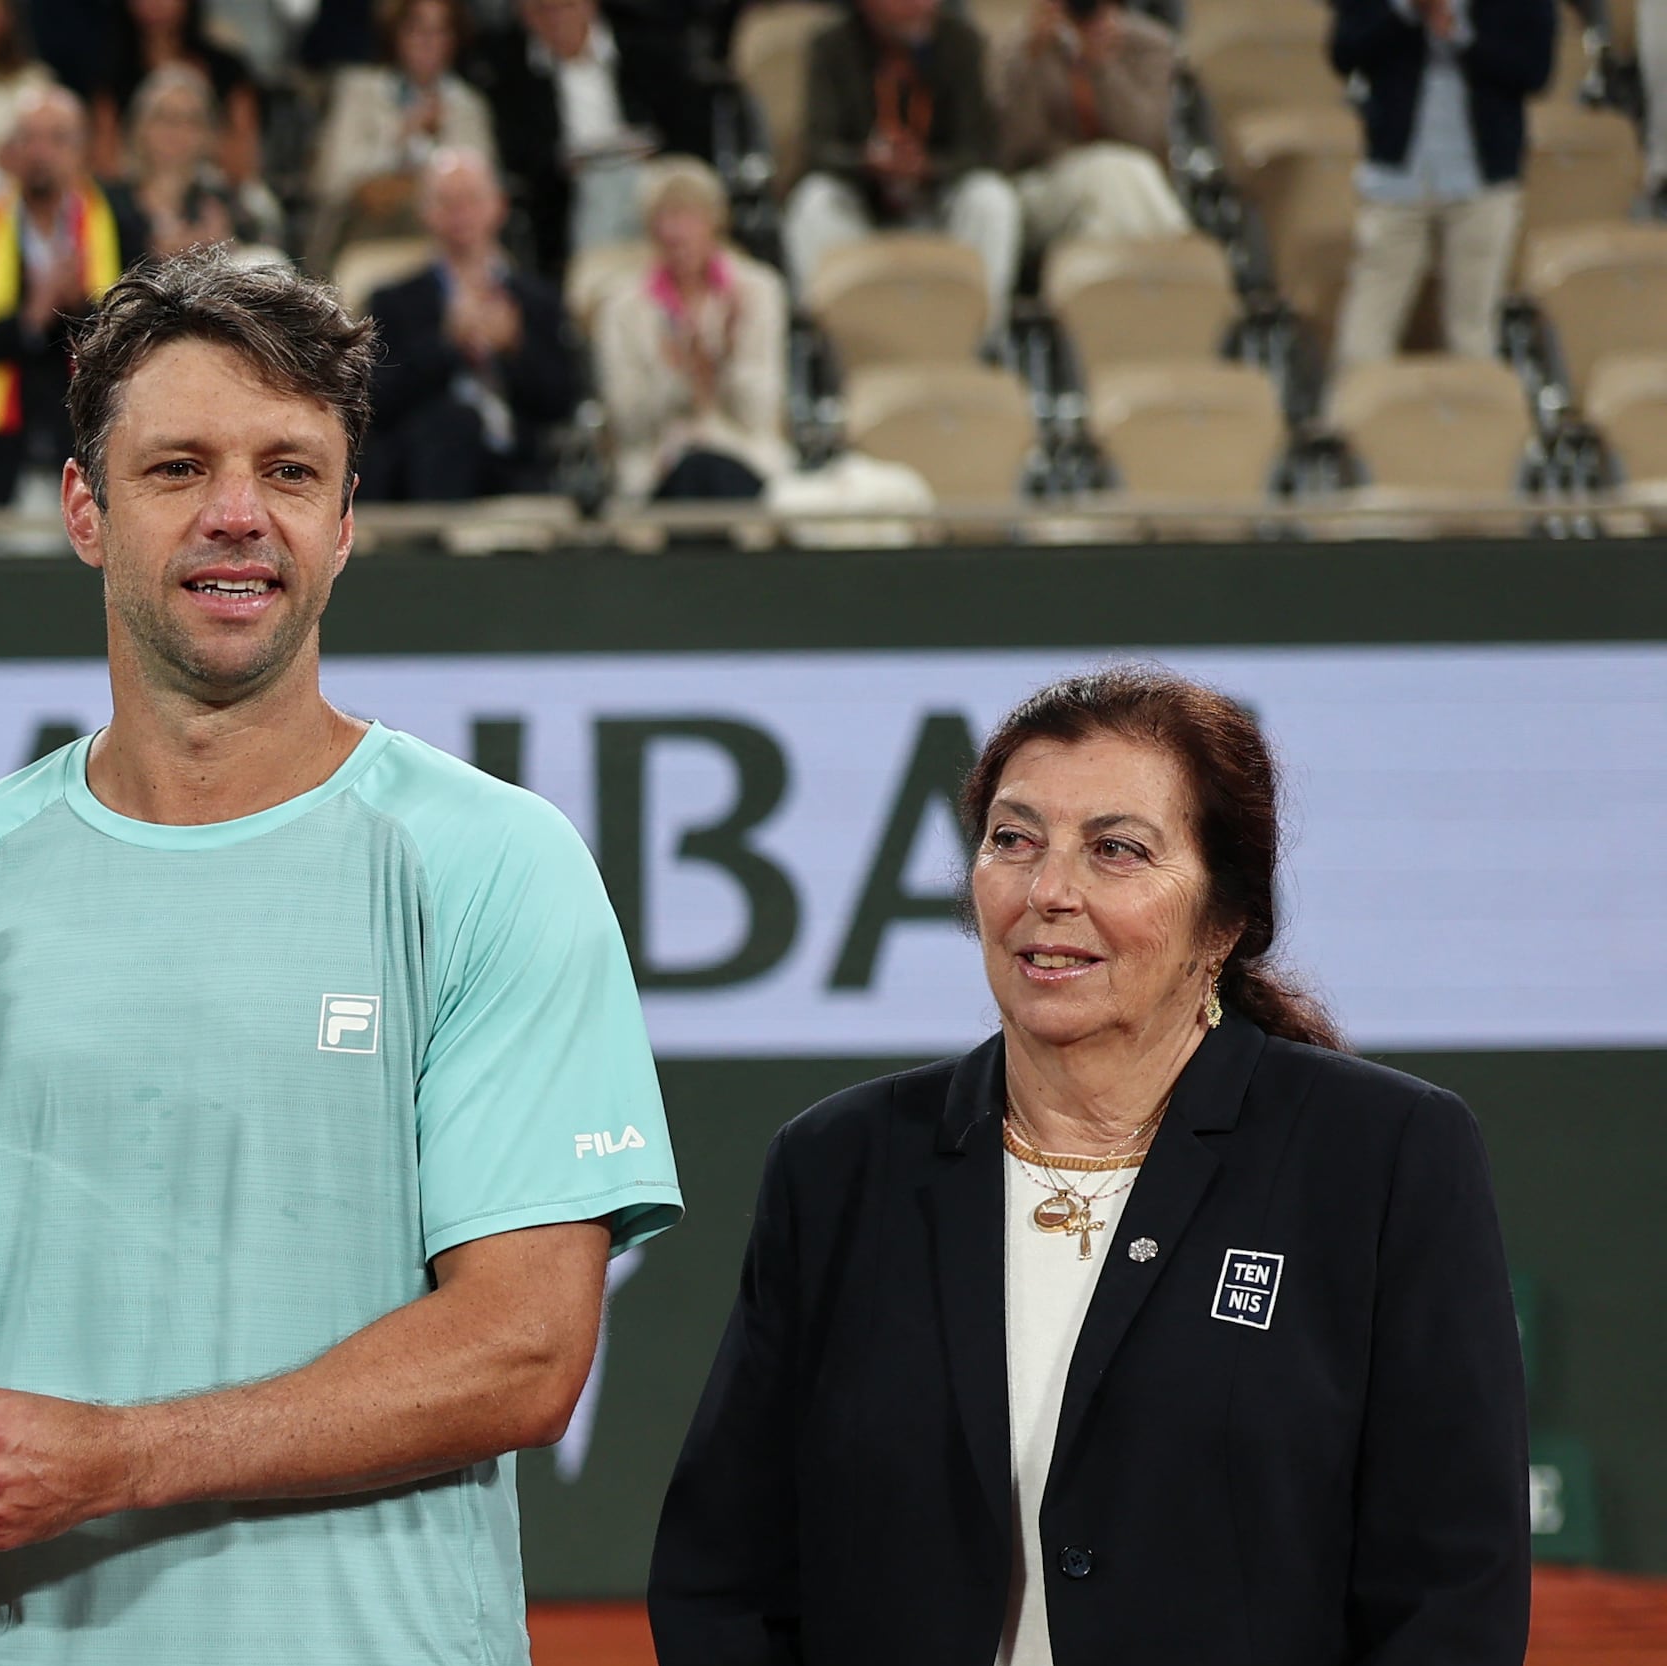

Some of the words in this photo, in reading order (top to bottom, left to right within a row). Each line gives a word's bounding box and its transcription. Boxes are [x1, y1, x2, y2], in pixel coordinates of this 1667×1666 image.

[574, 1125, 646, 1159] FILA
[1234, 1263, 1271, 1286] TEN
[1228, 1290, 1263, 1313] NIS
